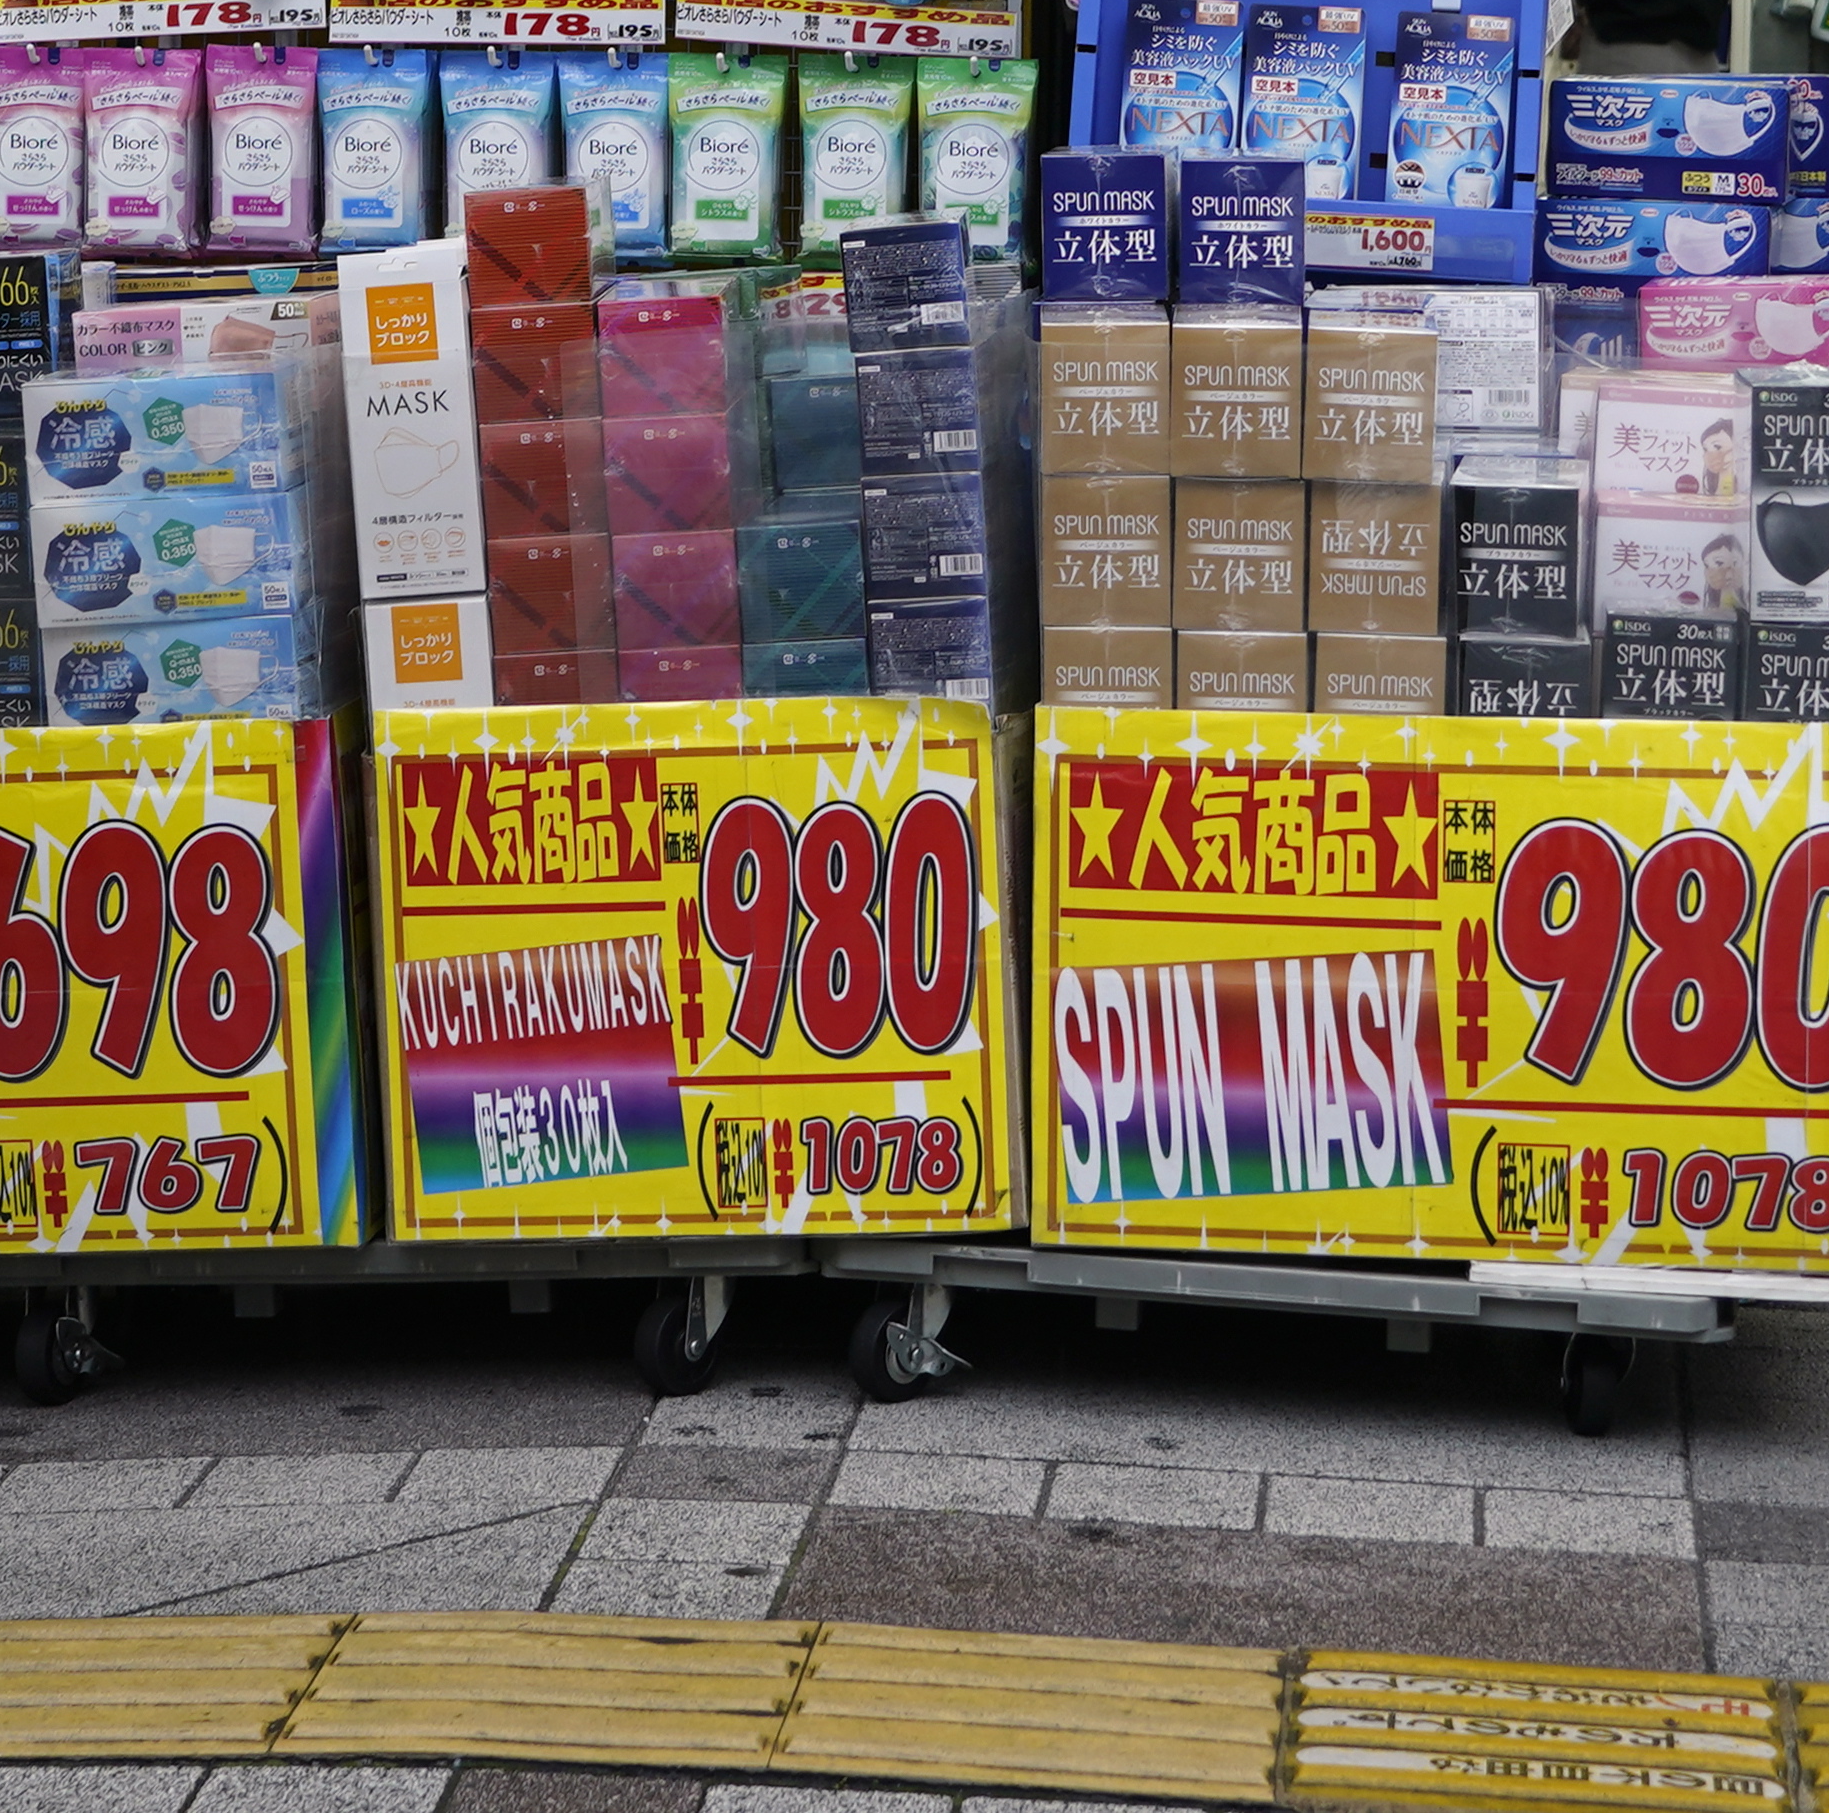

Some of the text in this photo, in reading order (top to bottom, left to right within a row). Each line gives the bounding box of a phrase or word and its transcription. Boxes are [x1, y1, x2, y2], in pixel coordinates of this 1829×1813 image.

[1151, 34, 1216, 52] シミを防ぐ
[1131, 51, 1236, 71] 美容液パックUV
[1421, 49, 1489, 66] シミを防ぐ
[1132, 72, 1175, 86] 空見本
[1400, 64, 1505, 85] 美容液パックUV
[1402, 87, 1443, 101] 空見本
[1566, 94, 1654, 119] 三次元
[1131, 108, 1228, 136] NEXTA
[10, 133, 59, 151] Bioré
[113, 134, 159, 151] Bioré
[1401, 122, 1499, 151] NEXTA
[1737, 174, 1762, 196] 30
[1546, 213, 1634, 239] 三次元
[1052, 229, 1157, 265] 立体型
[1189, 234, 1295, 270] 立体型
[0, 266, 29, 308] 66
[76, 319, 175, 337] カラー不織布マスク
[375, 313, 428, 329] しっかり
[79, 340, 169, 356] COLOR ピンク
[375, 329, 430, 346] ブロック
[366, 388, 450, 418] MASK
[49, 415, 116, 451] 冷感
[1764, 414, 1813, 436] SPUN
[1638, 457, 1691, 474] マスク
[56, 538, 124, 574] 冷感
[400, 633, 453, 648] しっかり
[400, 649, 454, 665] ブロック
[699, 791, 976, 1058] 980
[1054, 951, 1446, 1202] SPUN MASK
[801, 1116, 963, 1195] 1078
[72, 1135, 262, 1219] 767
